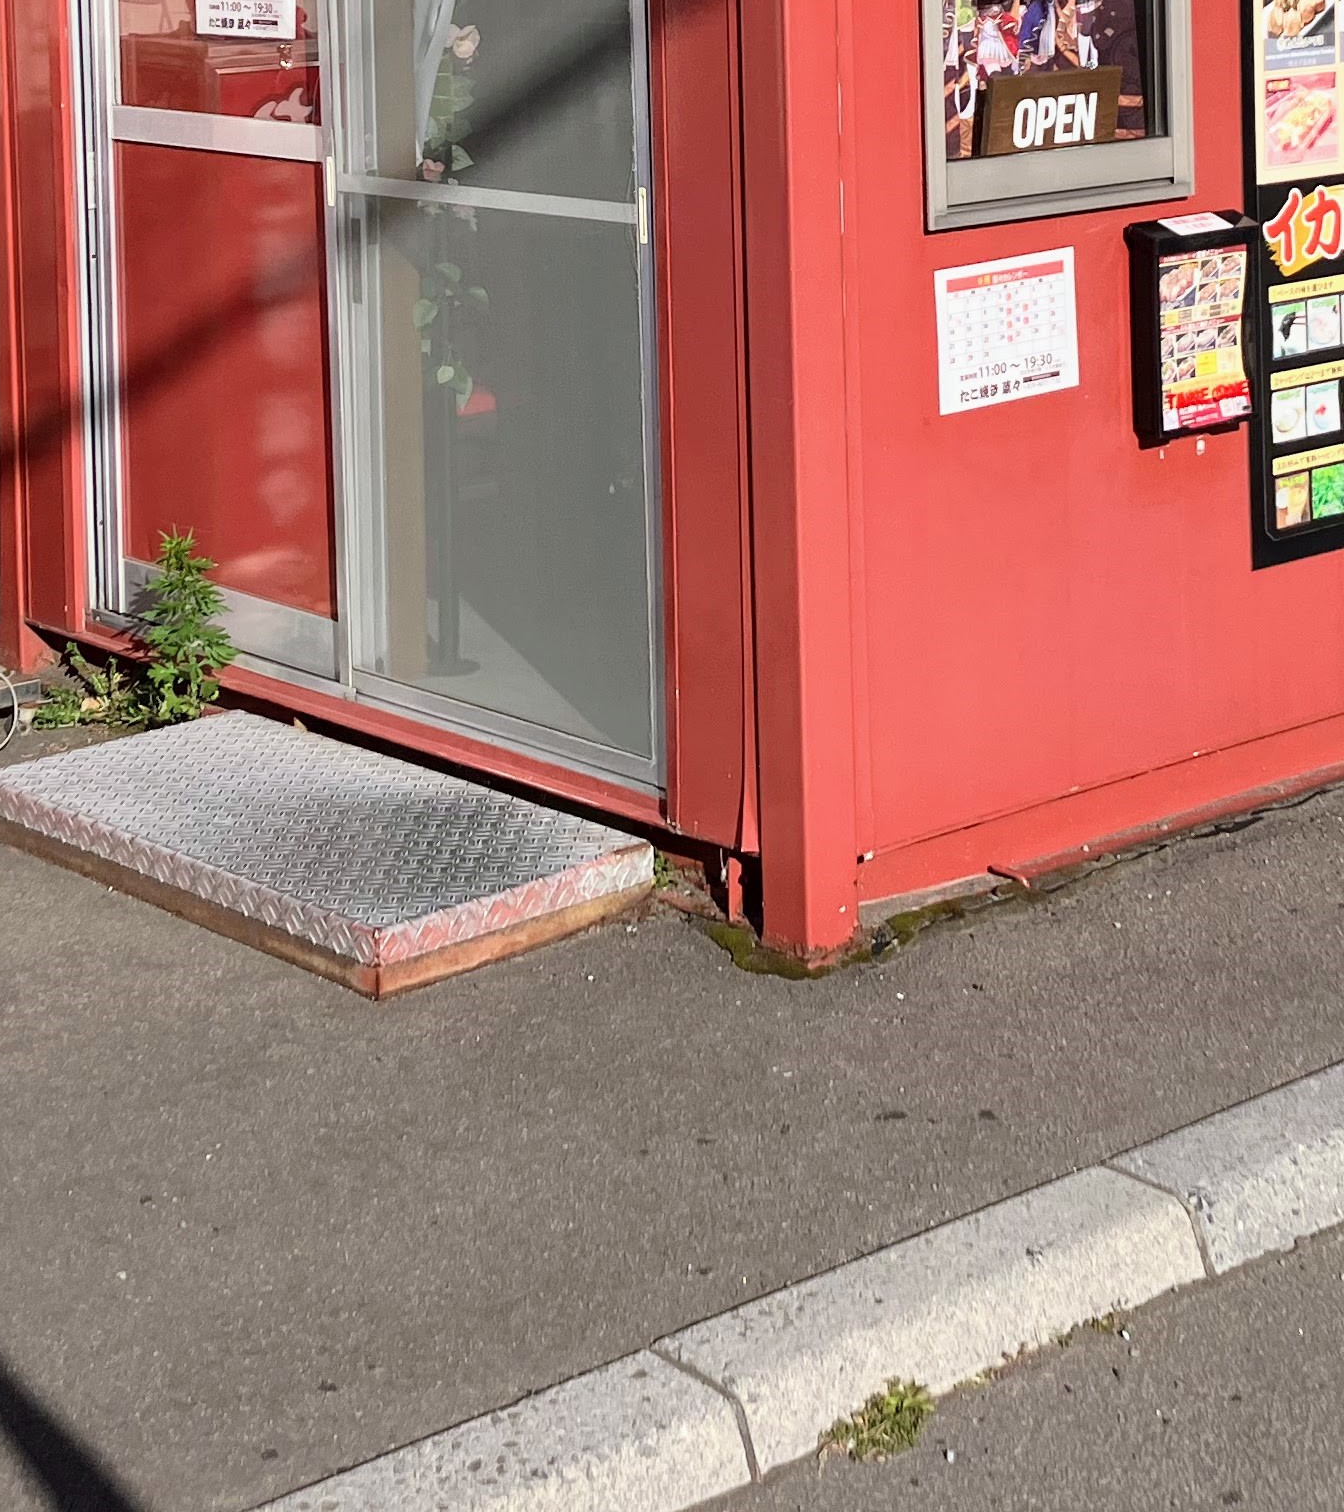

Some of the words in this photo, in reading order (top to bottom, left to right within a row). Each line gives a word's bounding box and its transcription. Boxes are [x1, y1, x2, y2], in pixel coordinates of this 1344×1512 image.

[1012, 92, 1098, 149] OPEN
[979, 362, 1006, 378] 11:00
[1024, 353, 1053, 369] 19:30
